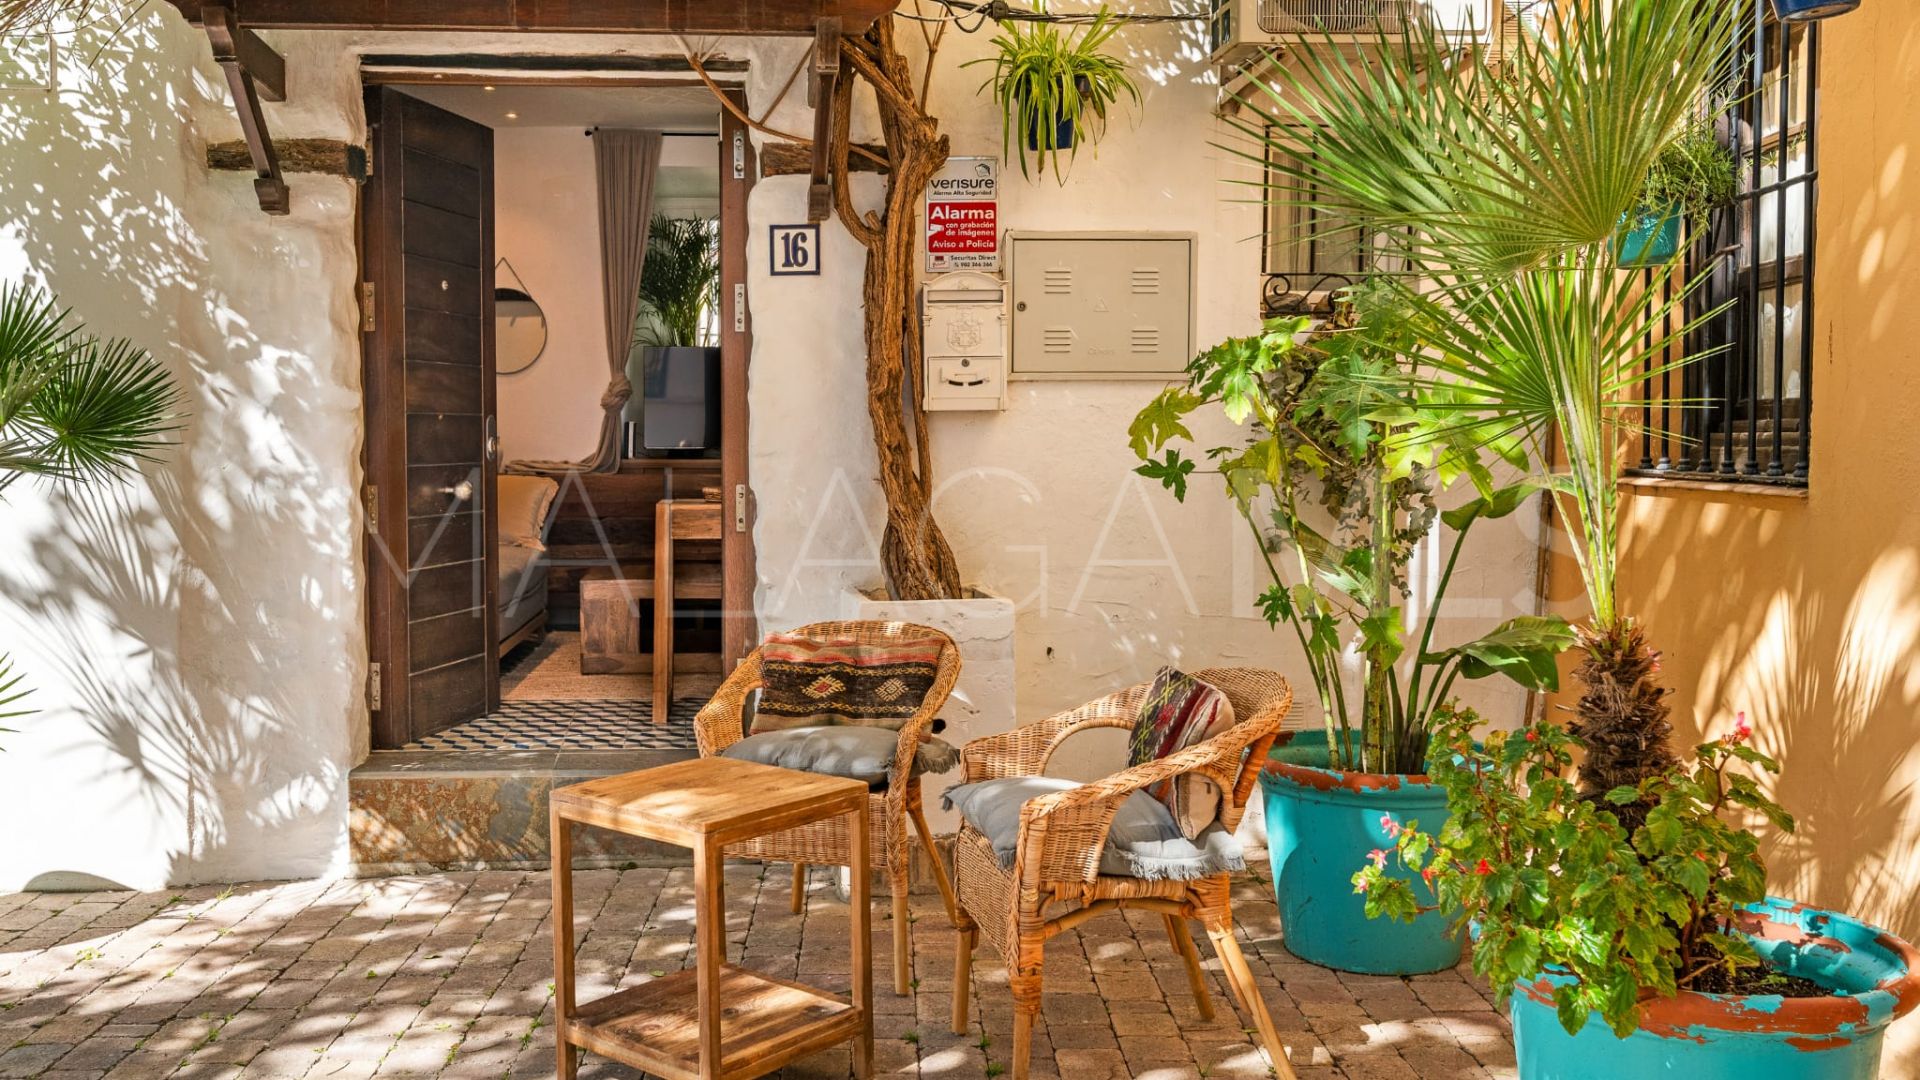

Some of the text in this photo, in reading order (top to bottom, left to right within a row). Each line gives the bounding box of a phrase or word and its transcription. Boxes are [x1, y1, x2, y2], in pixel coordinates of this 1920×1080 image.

[931, 179, 994, 188] verisure
[931, 205, 994, 219] Alarma
[960, 221, 995, 230] grabación
[957, 229, 995, 238] imágenes
[932, 240, 957, 248] Aviso
[966, 240, 995, 248] Policía
[780, 231, 808, 268] 16
